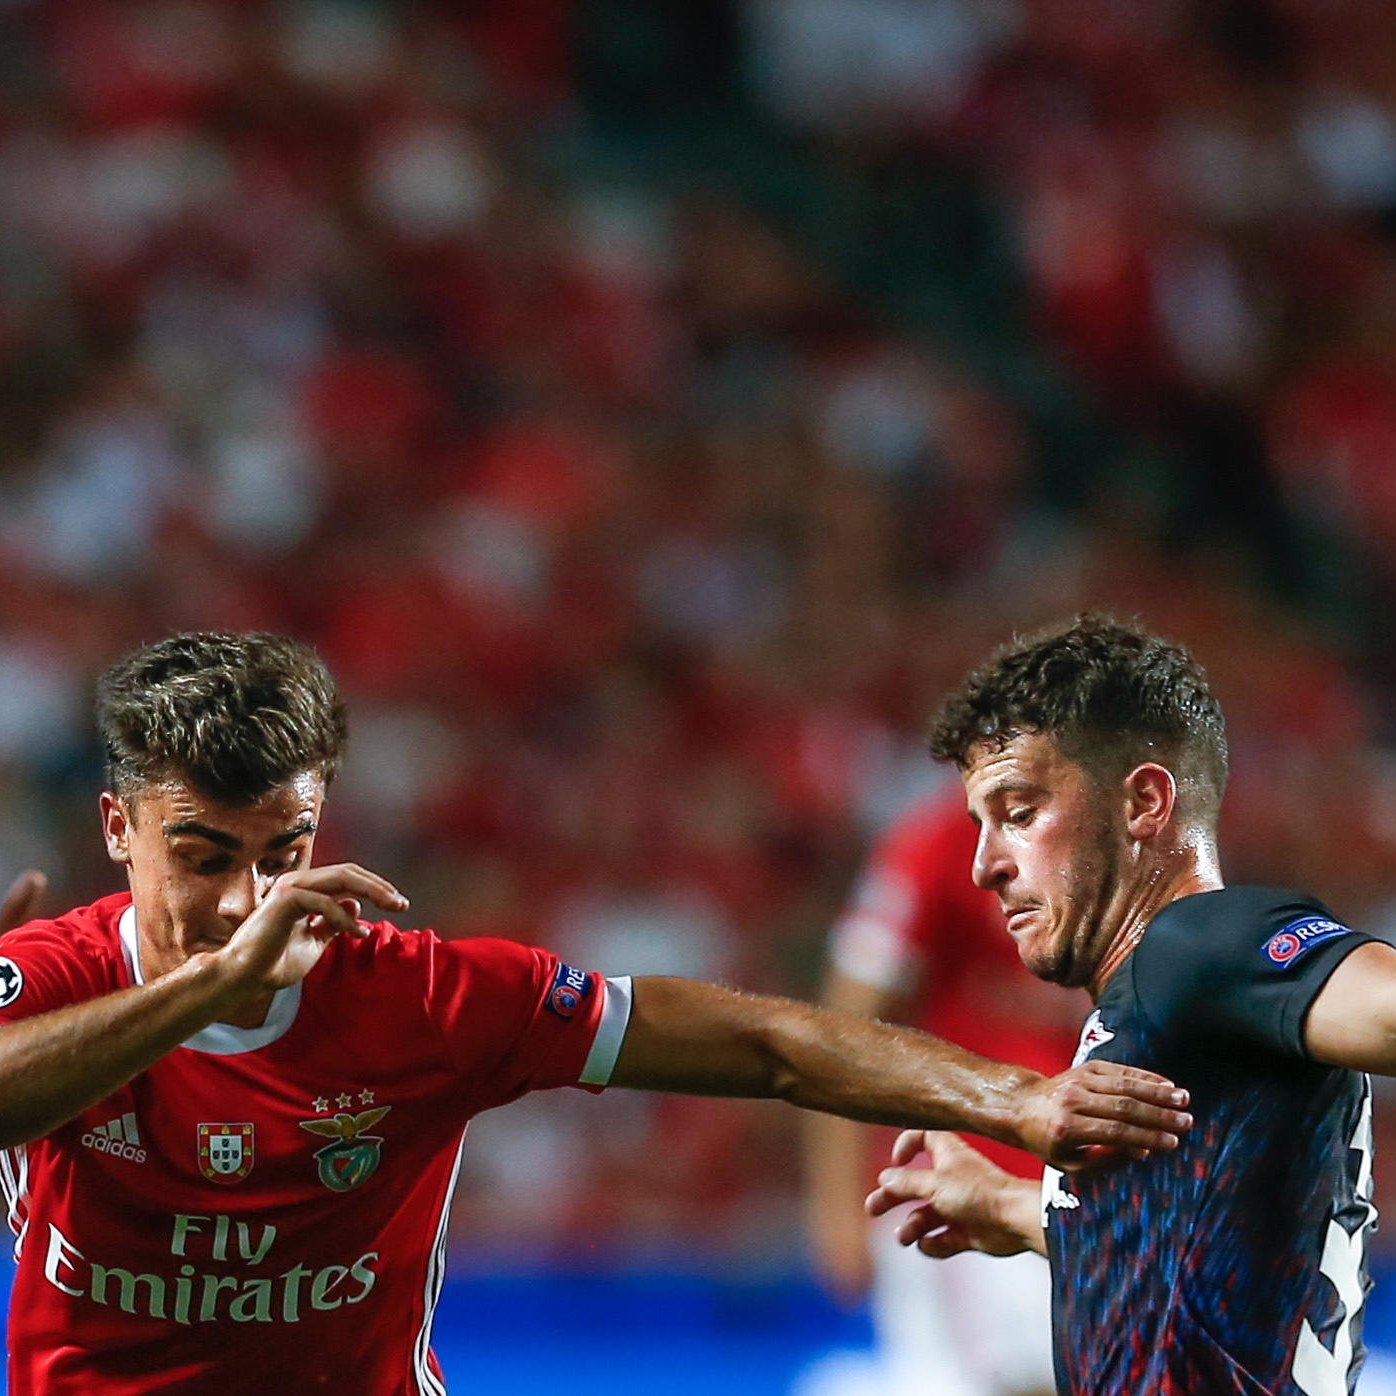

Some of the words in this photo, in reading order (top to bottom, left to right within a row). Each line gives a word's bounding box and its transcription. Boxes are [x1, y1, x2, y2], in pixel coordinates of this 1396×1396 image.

[81, 1133, 147, 1163] adidas
[170, 1213, 277, 1266] Fly
[43, 1222, 380, 1325] Emirates
